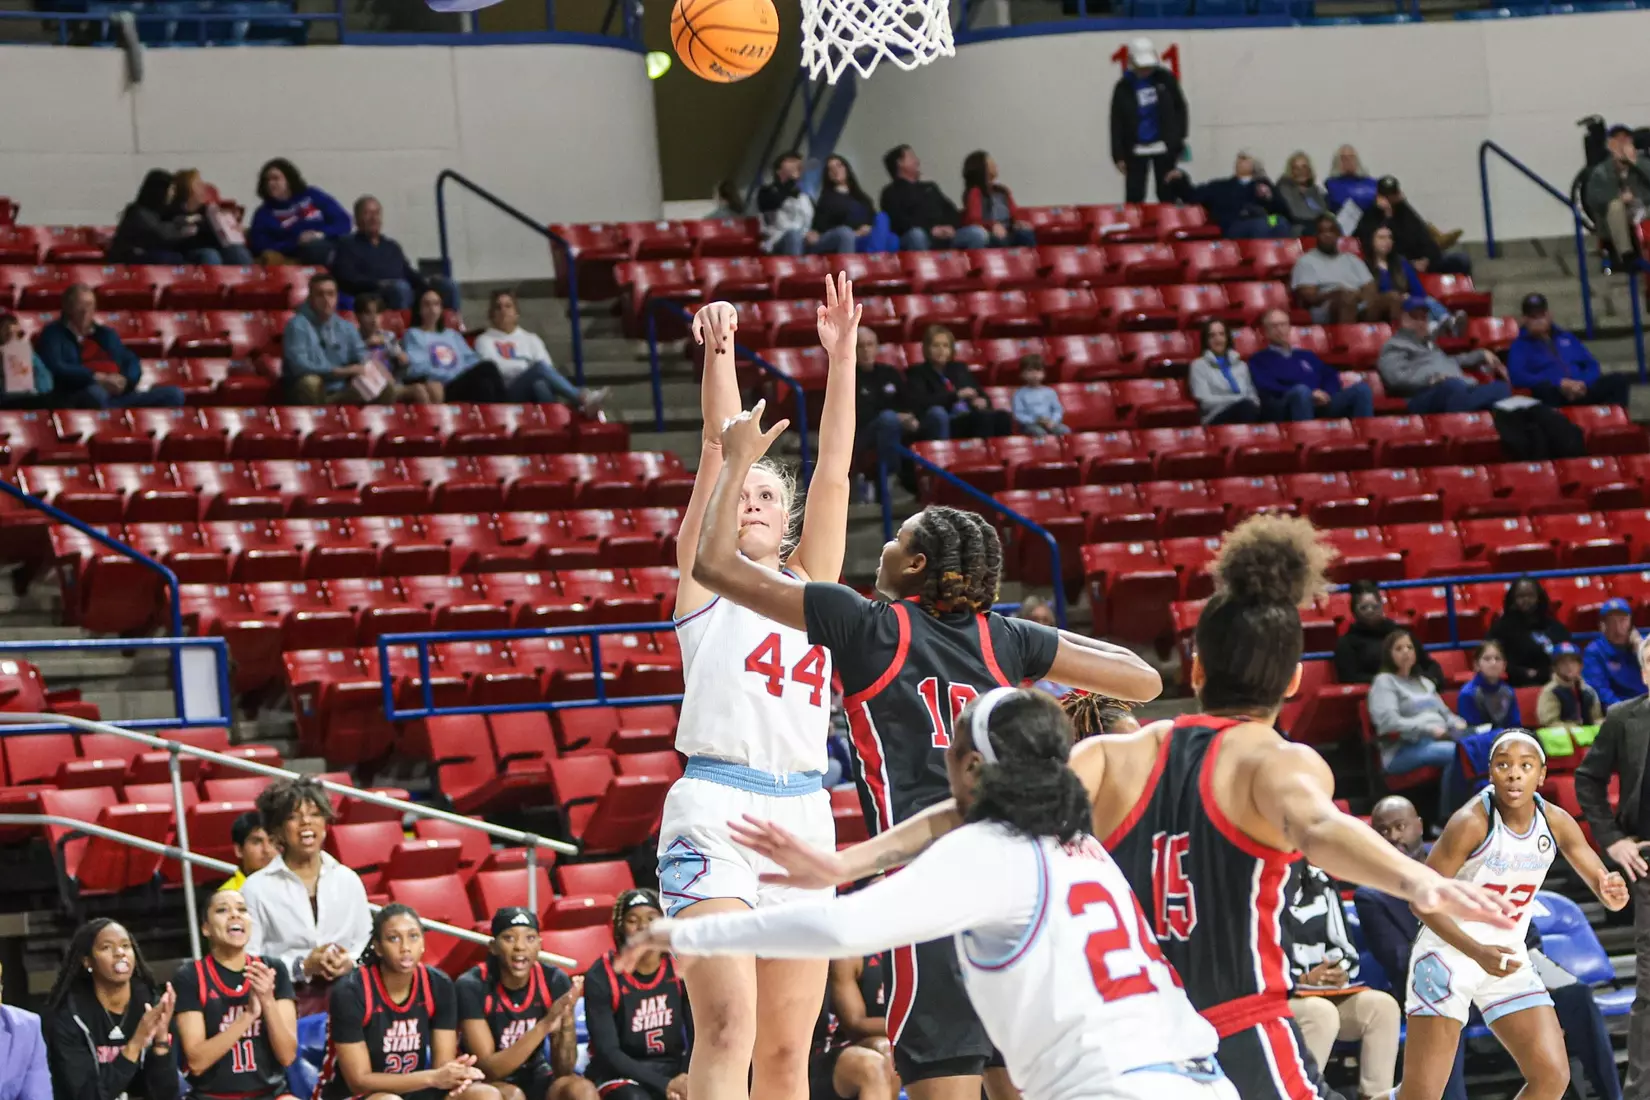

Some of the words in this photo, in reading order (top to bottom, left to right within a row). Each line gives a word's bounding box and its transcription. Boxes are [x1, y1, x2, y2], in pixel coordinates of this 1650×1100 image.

[745, 632, 825, 707] 44
[1152, 831, 1198, 942] 15
[635, 994, 668, 1016] JAX
[386, 1018, 419, 1036] JAX
[631, 1008, 673, 1032] STATE
[382, 1033, 421, 1053] STATE
[645, 1028, 665, 1054] 5
[232, 1040, 257, 1073] 11
[385, 1052, 418, 1075] 22
